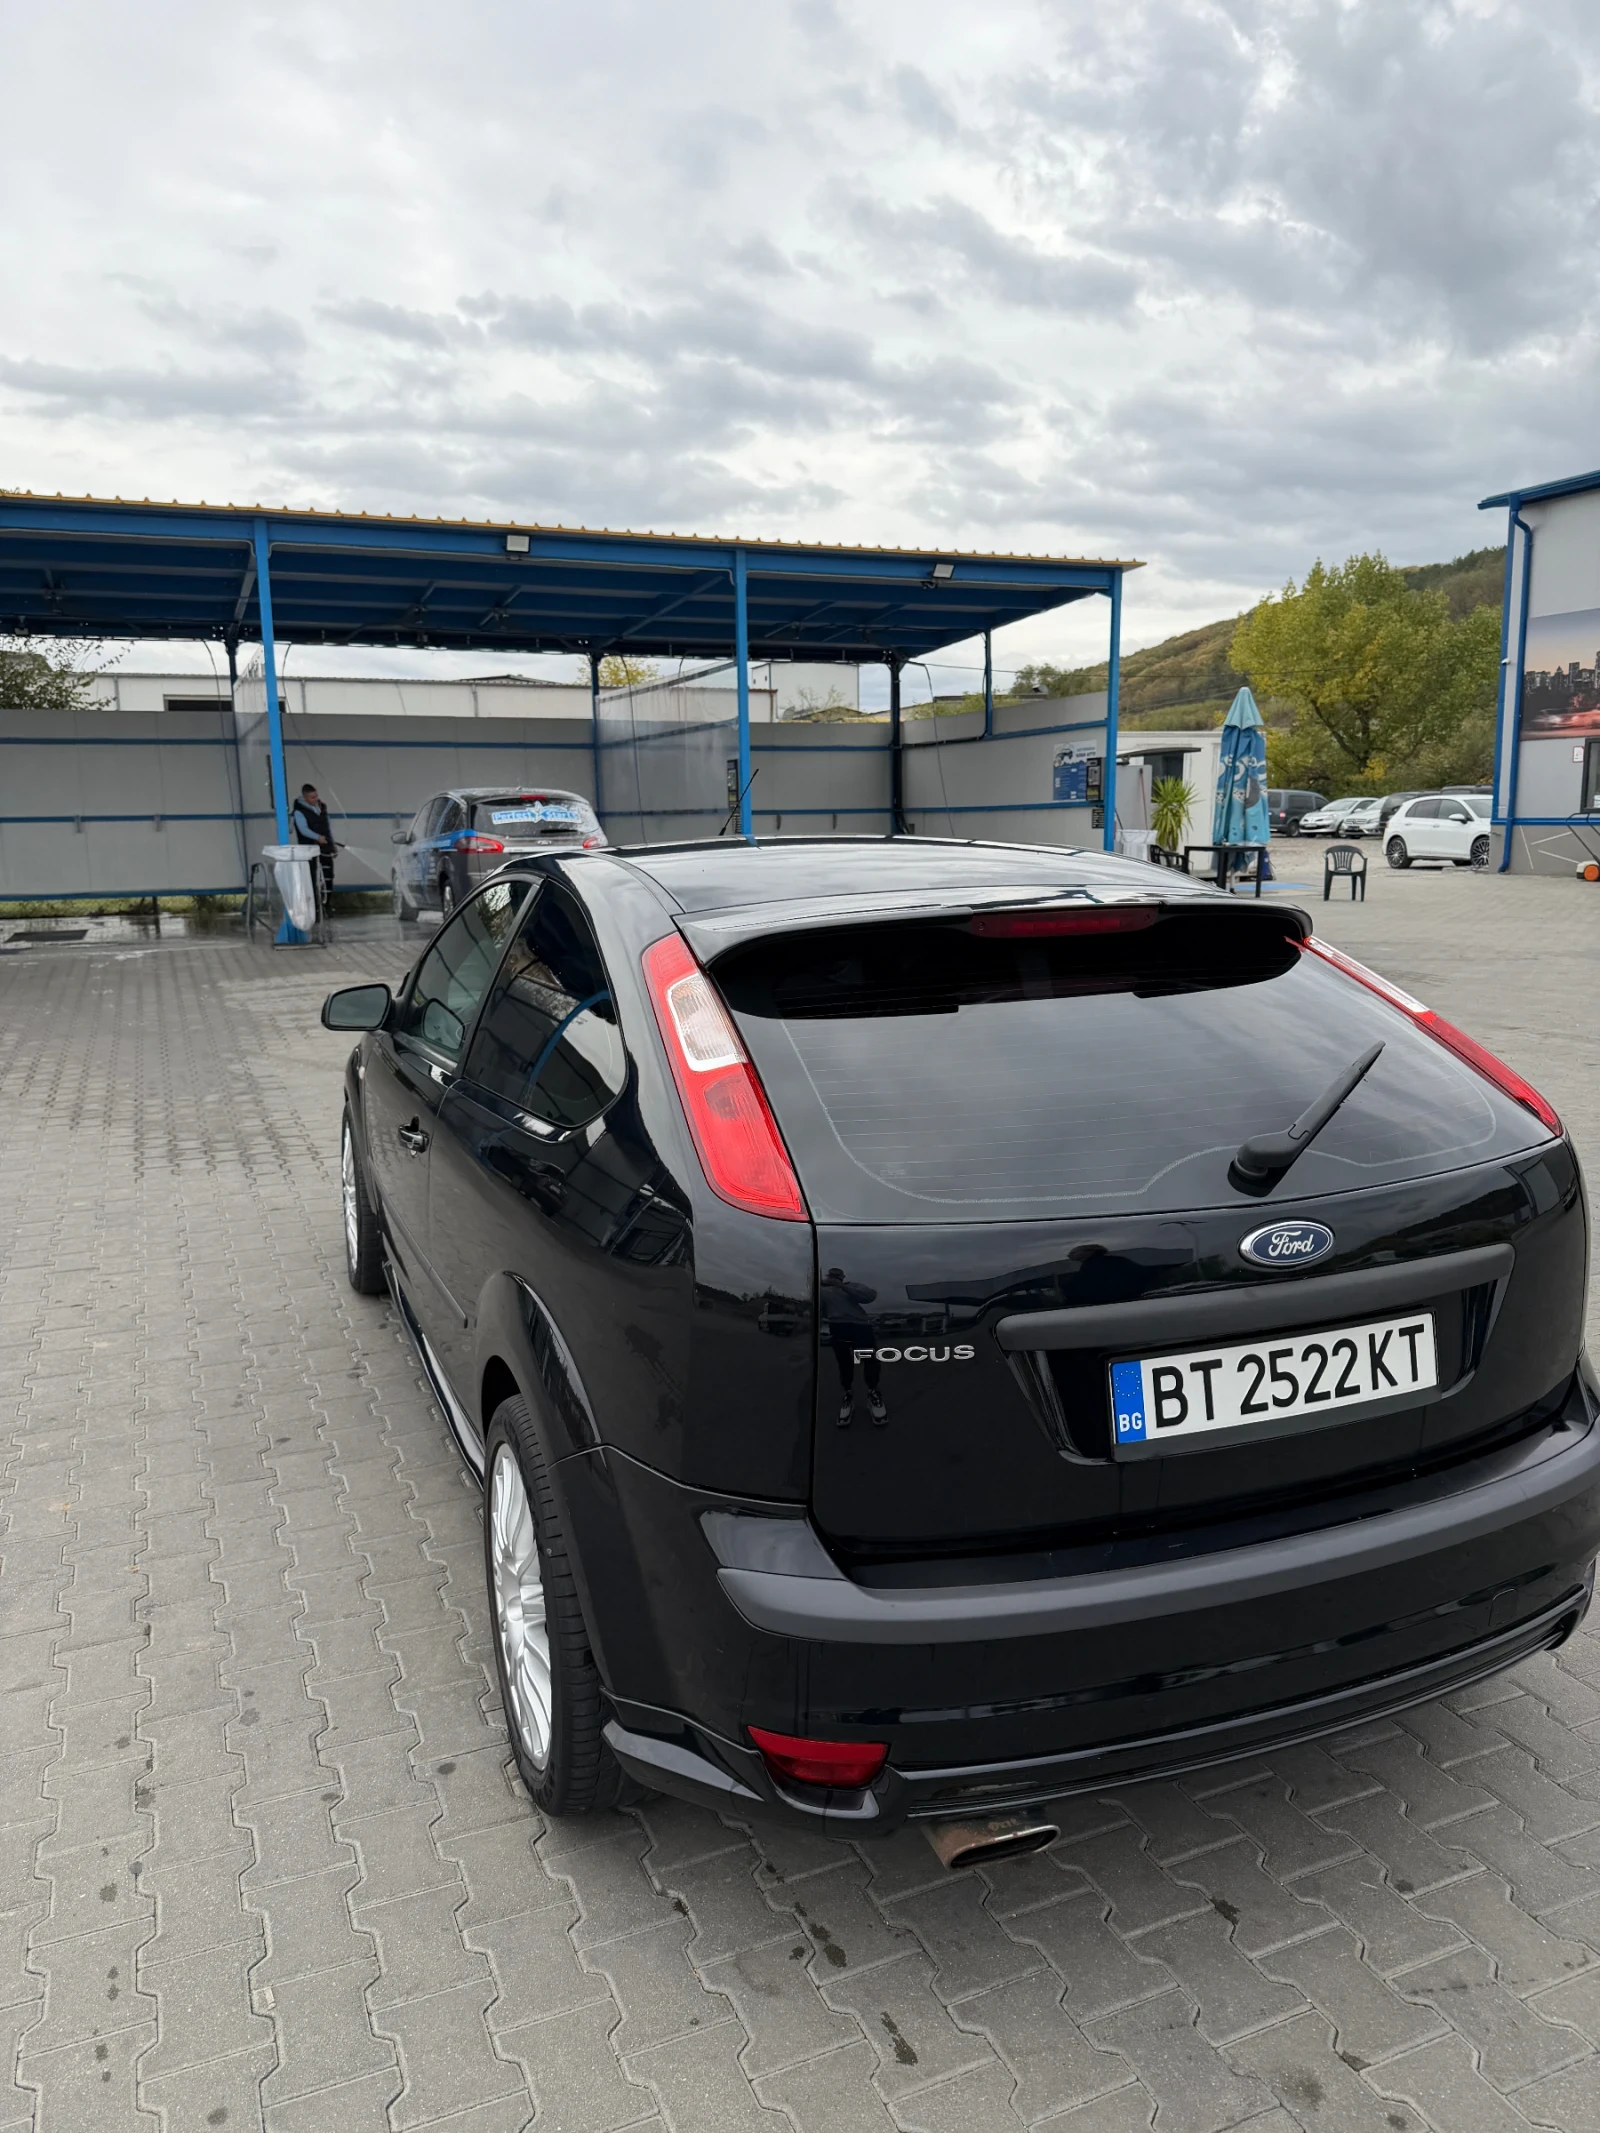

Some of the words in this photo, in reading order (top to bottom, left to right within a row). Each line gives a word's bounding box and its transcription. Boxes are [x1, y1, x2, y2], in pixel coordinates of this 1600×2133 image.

[493, 810, 530, 822] Perfect
[1268, 1230, 1315, 1257] Ford
[853, 1344, 975, 1364] FOCUS
[1152, 1358, 1223, 1429] BT
[1236, 1337, 1361, 1416] 2522
[1368, 1323, 1425, 1391] KT
[1118, 1411, 1143, 1432] BG
